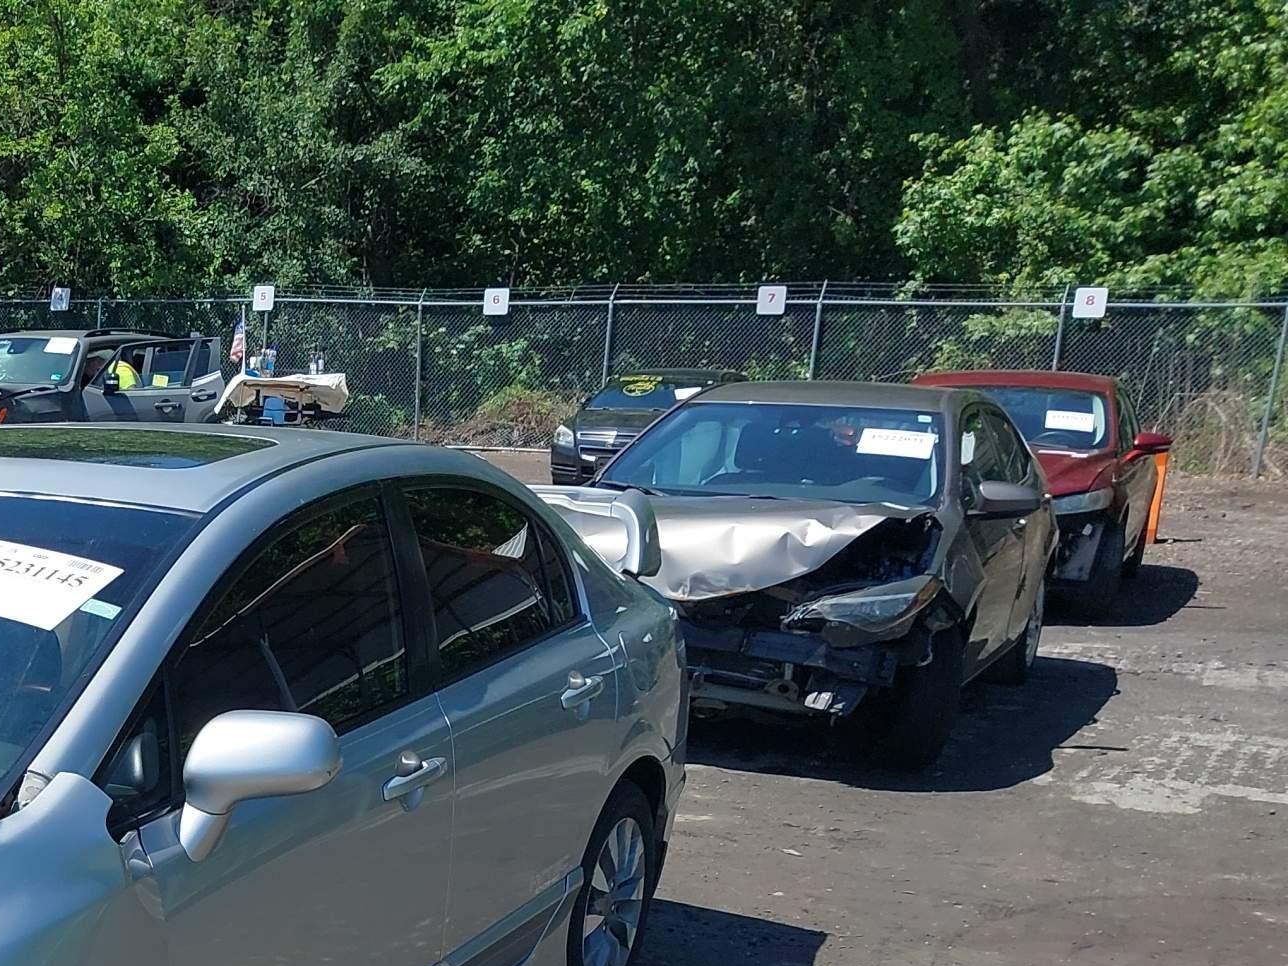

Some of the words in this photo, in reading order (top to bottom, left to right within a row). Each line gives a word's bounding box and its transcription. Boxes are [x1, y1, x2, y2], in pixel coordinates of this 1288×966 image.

[260, 292, 267, 301] 5
[493, 295, 500, 304] 6
[768, 293, 776, 303] 7
[1086, 295, 1096, 305] 8
